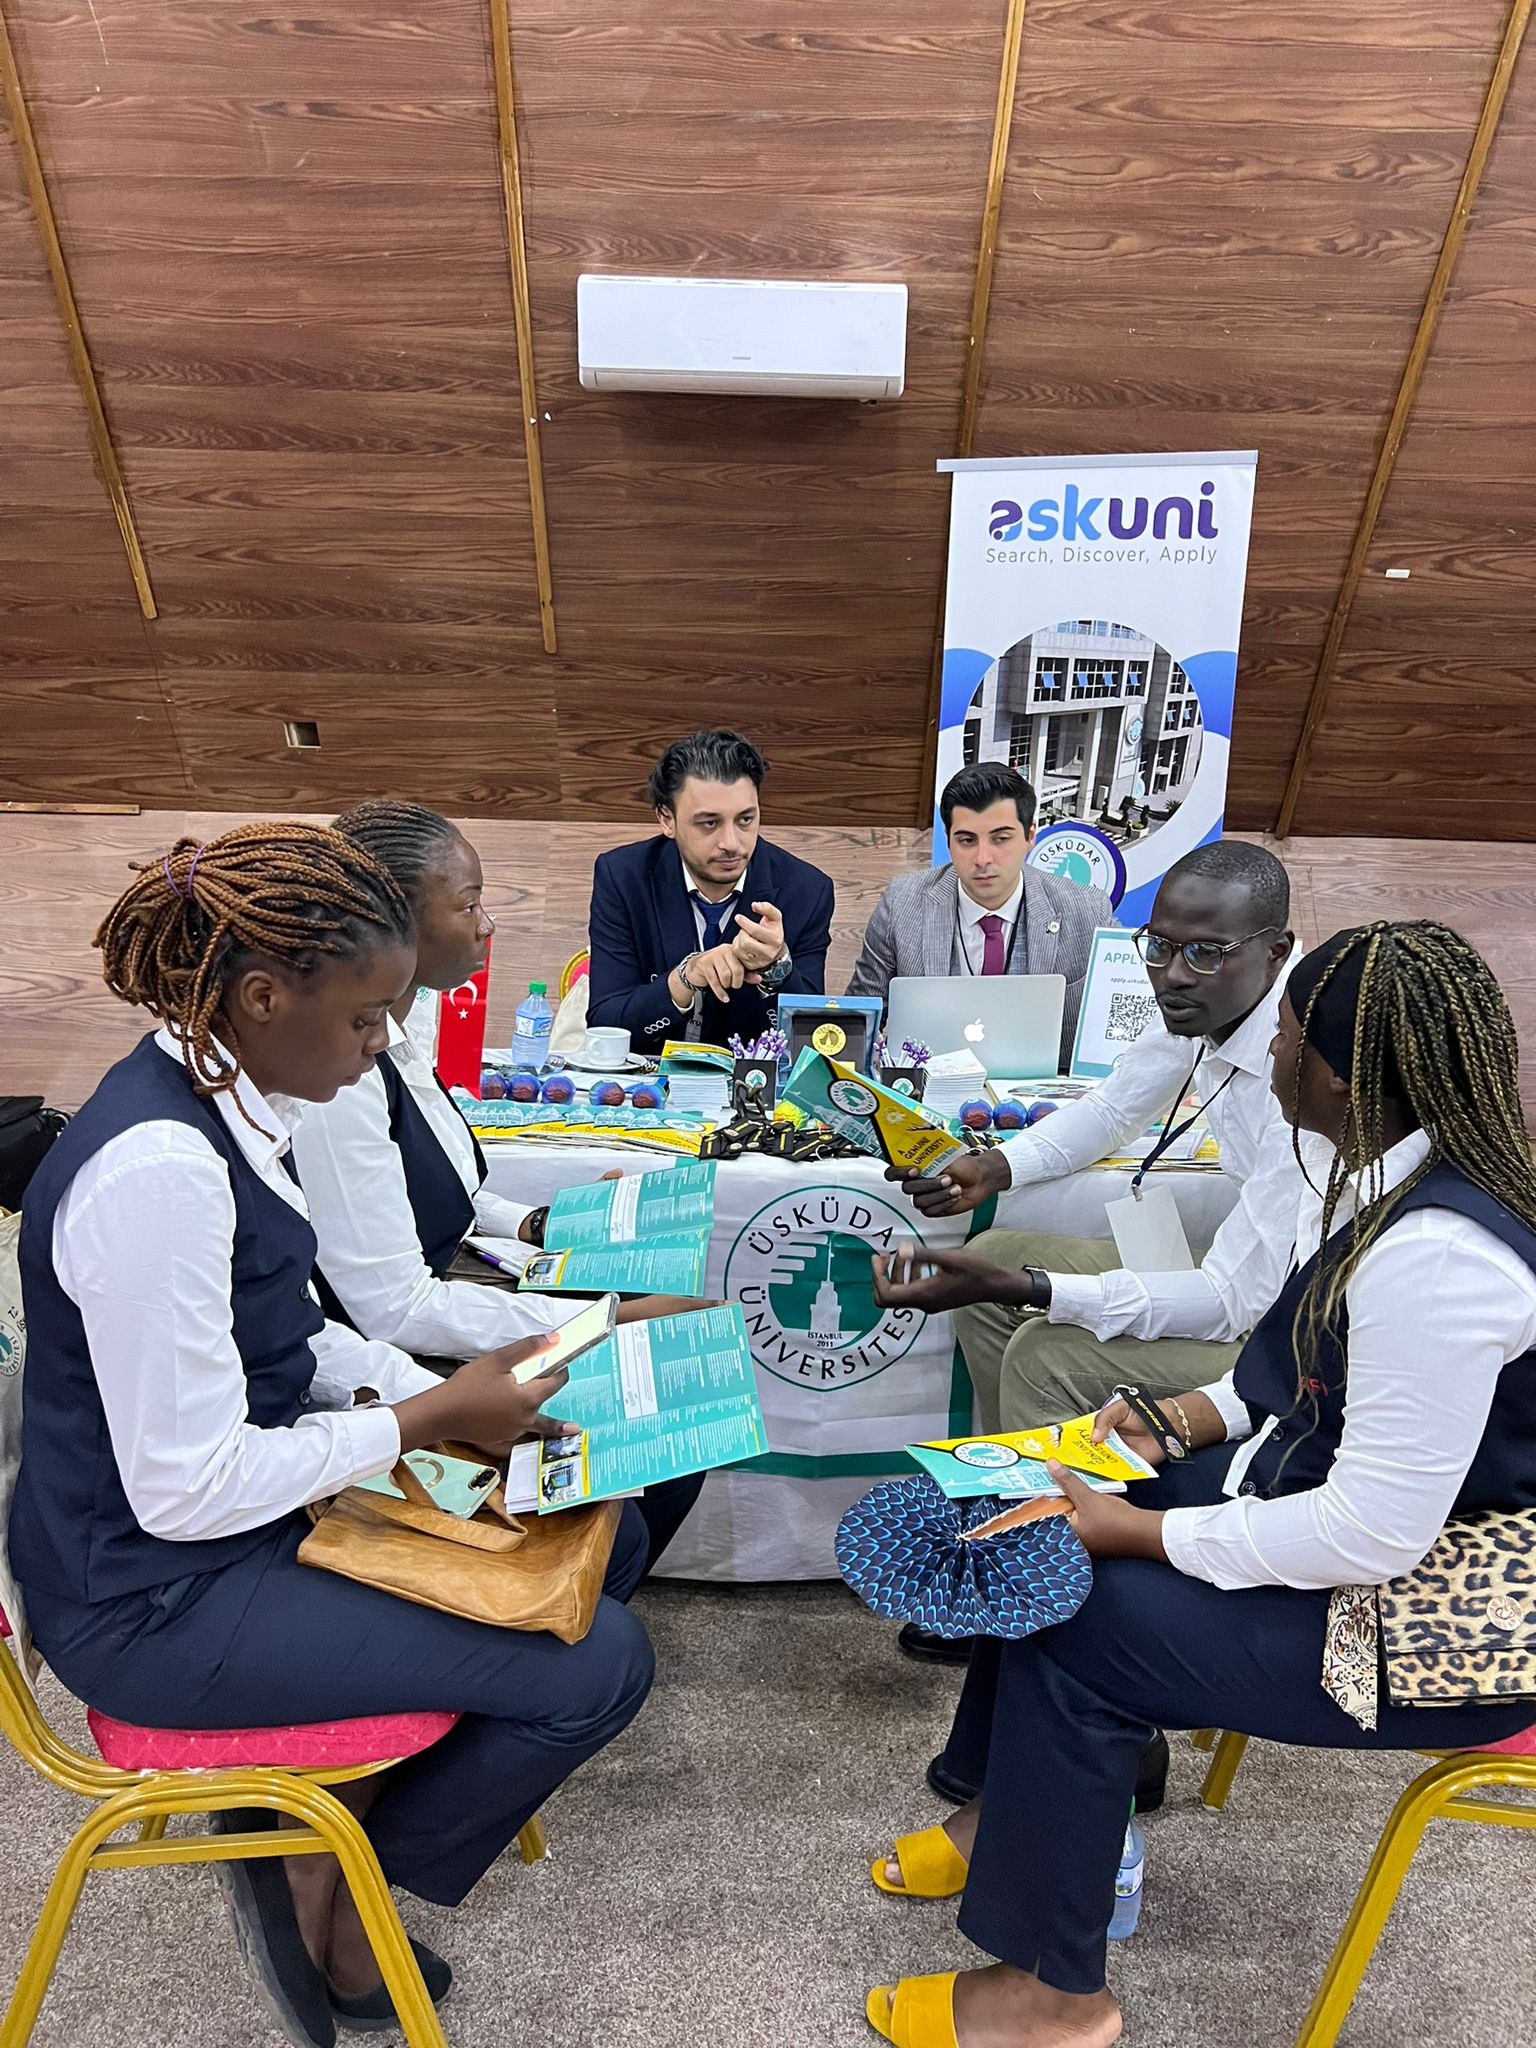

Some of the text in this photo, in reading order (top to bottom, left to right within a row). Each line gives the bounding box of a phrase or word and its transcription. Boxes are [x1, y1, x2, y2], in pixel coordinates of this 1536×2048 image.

[989, 481, 1219, 541] askuni
[986, 545, 1217, 564] Search, Discover, Apply
[897, 1149, 906, 1157] A
[904, 1136, 931, 1160] GENUINE
[913, 1138, 946, 1165] UNIVERSITY
[748, 1196, 897, 1255] ÜSKÜDA
[739, 1286, 913, 1380] ÜNİVERSİTES
[816, 1340, 834, 1348] 2011
